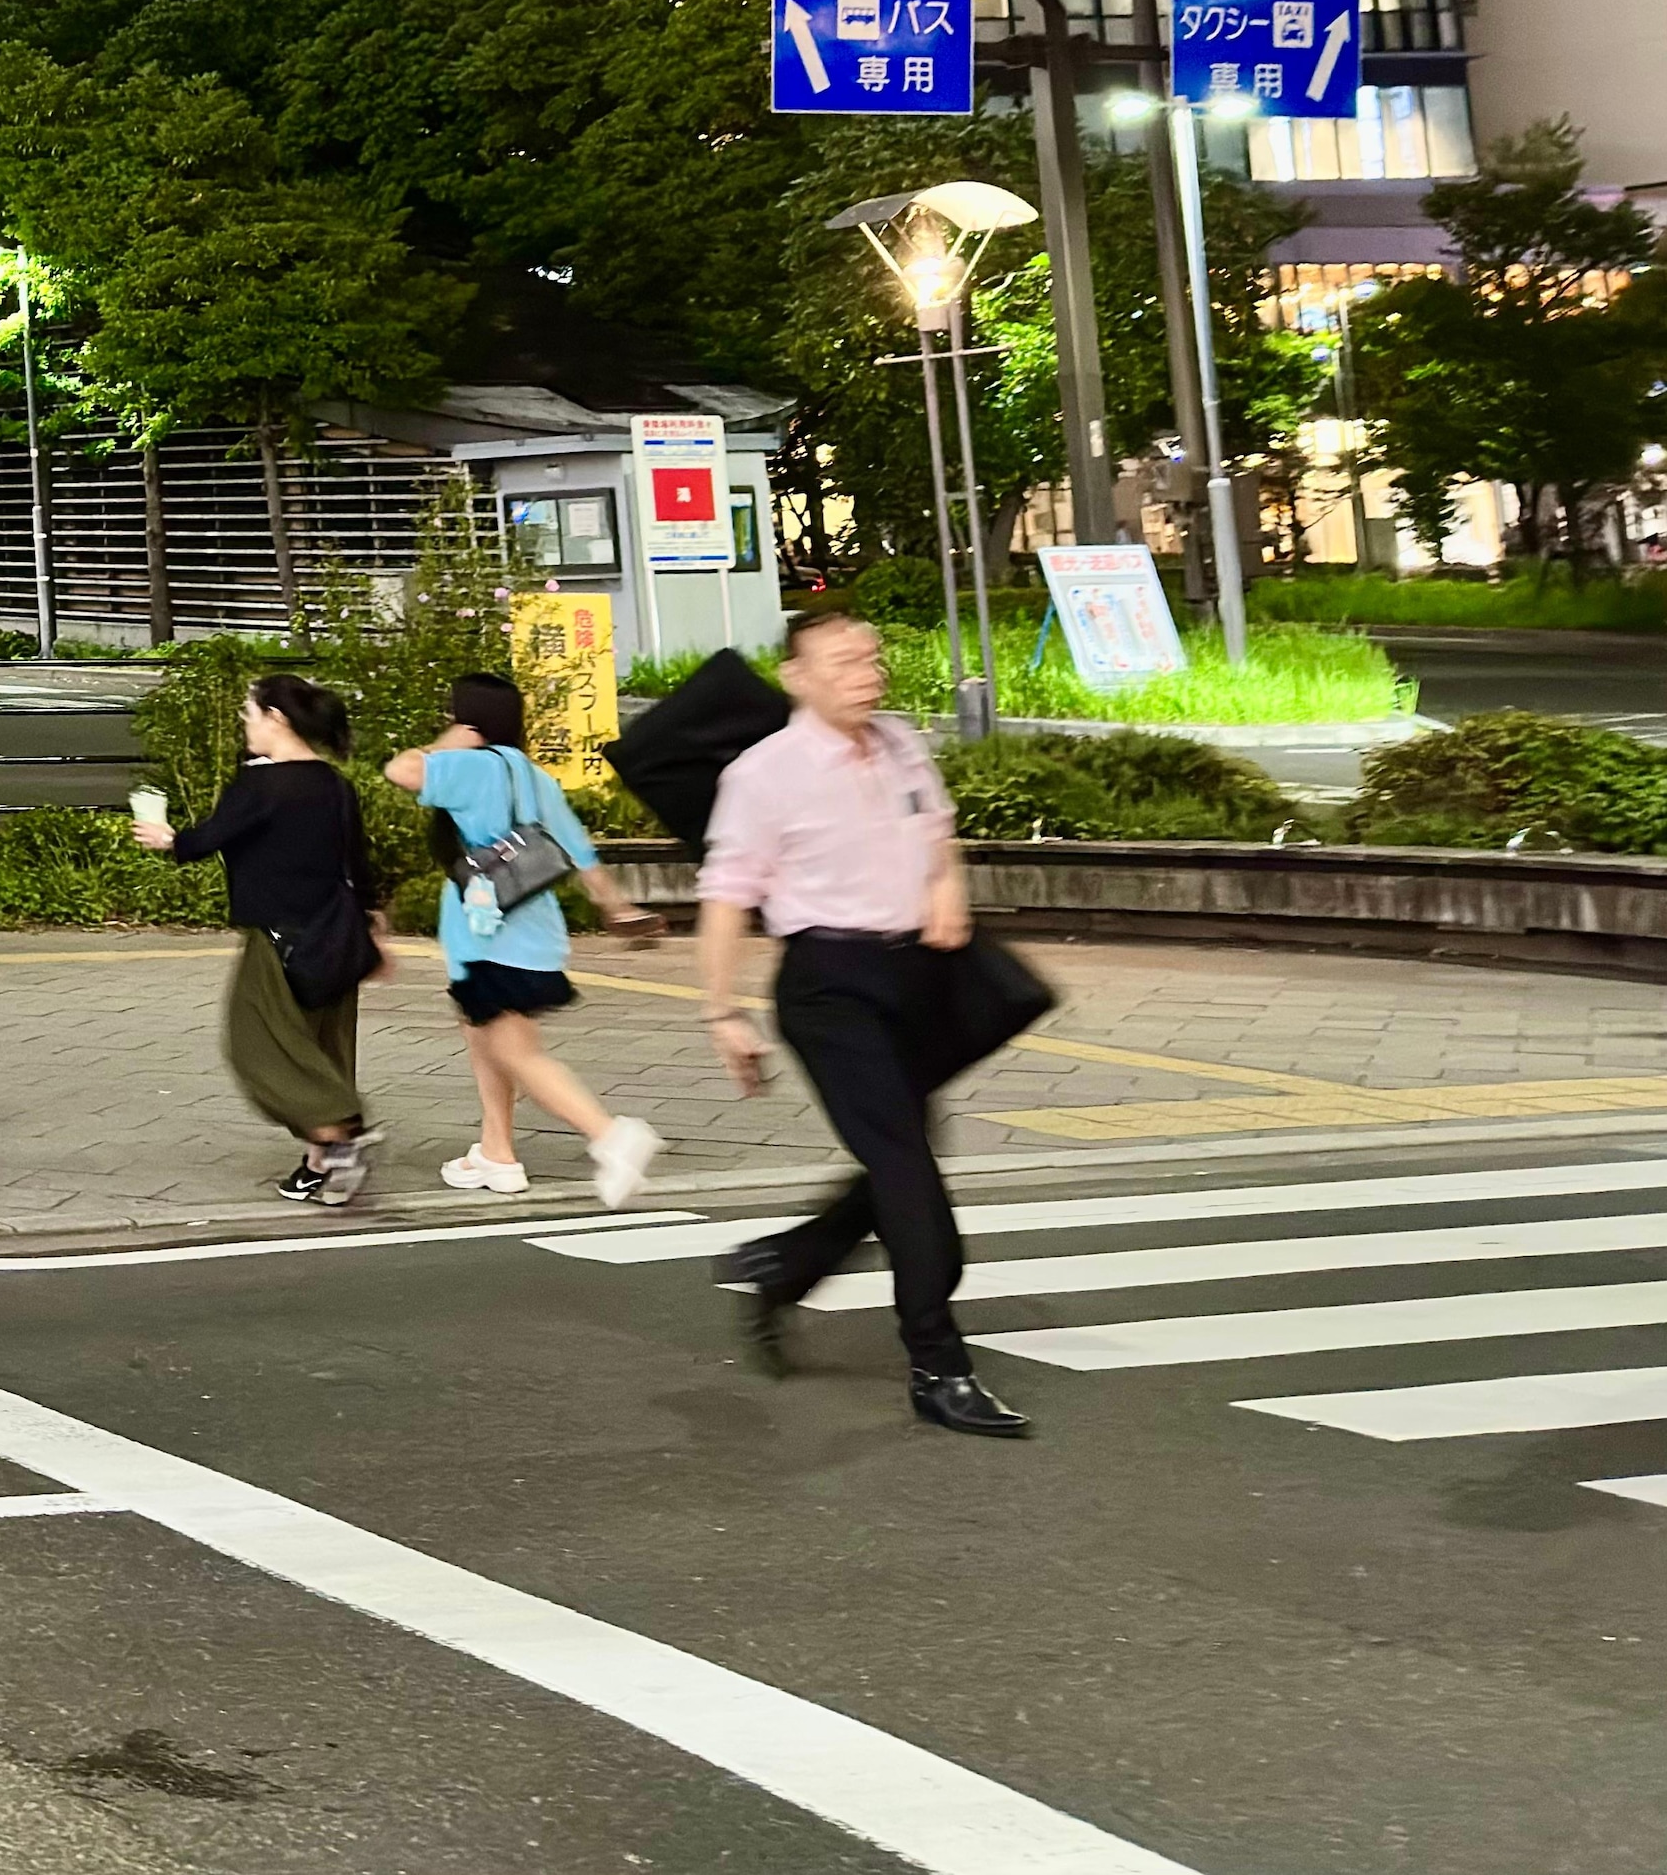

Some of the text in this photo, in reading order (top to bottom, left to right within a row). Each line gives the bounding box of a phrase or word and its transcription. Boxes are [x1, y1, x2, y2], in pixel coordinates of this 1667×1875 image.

[887, 0, 955, 36] バス
[1179, 5, 1271, 41] タクシー
[856, 55, 935, 94] 専用
[1209, 62, 1284, 99] 専用
